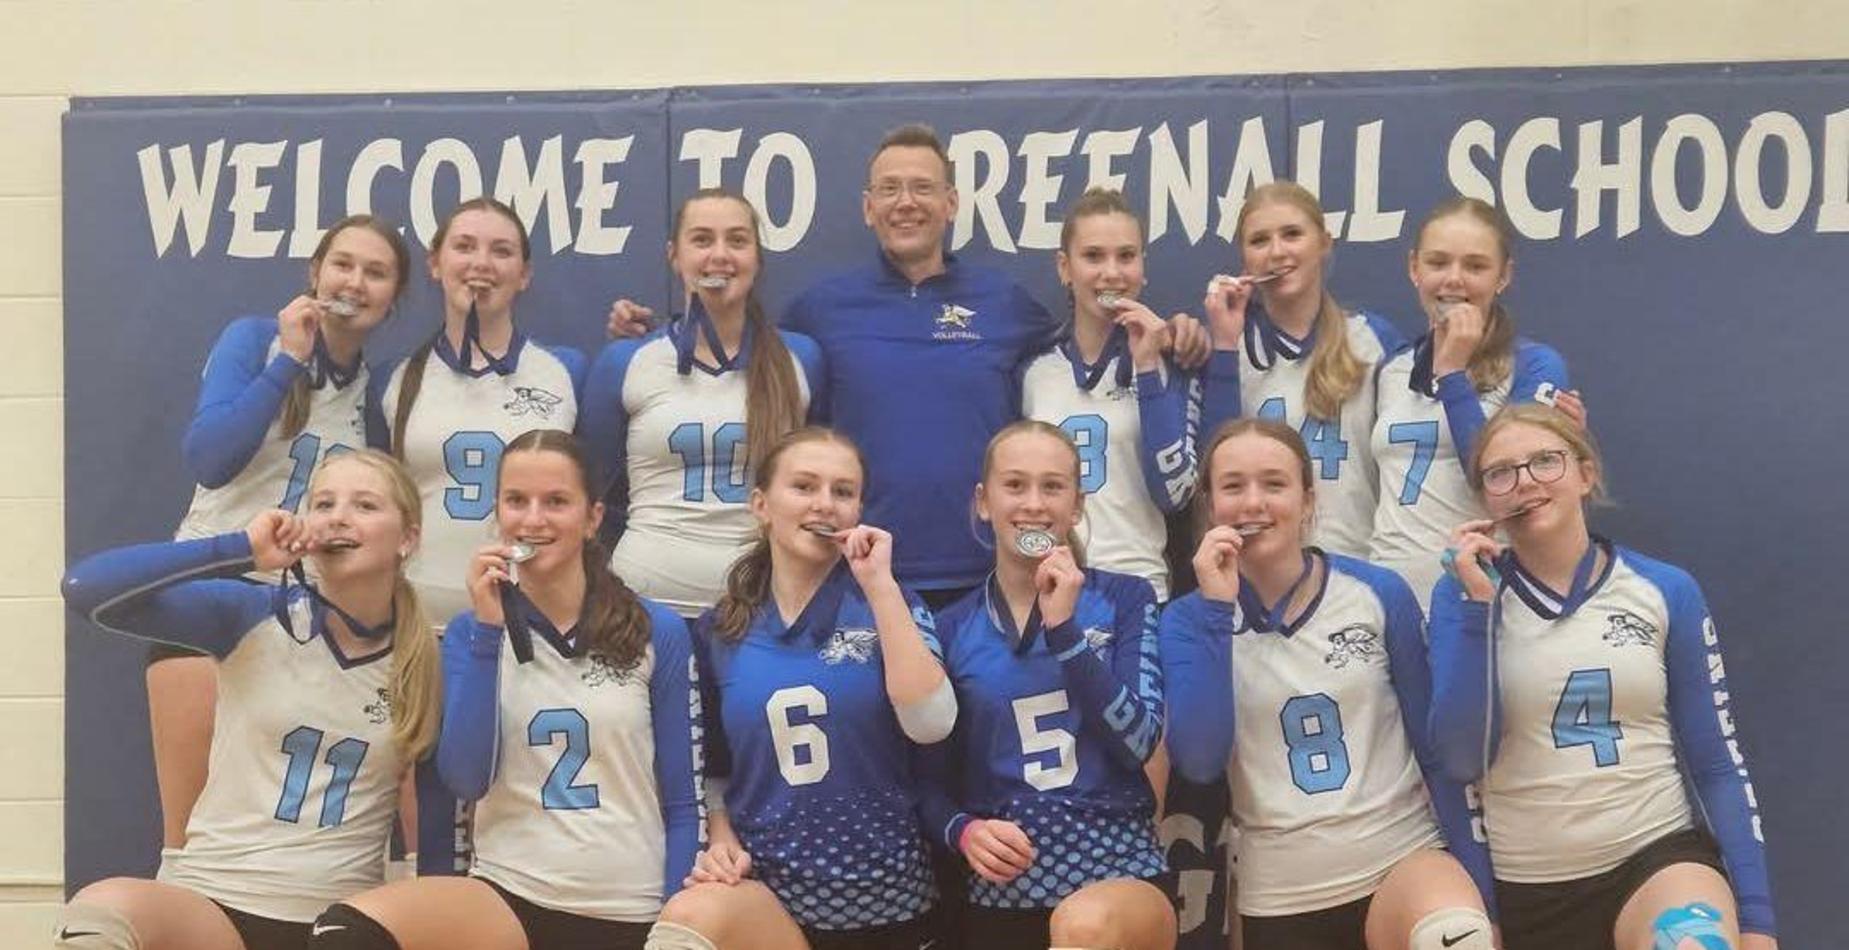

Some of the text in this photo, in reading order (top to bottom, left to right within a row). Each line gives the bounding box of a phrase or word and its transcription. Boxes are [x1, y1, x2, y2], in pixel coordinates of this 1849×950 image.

[137, 134, 635, 259] WELCOME
[679, 127, 817, 253] TO
[946, 116, 1405, 254] REENALL
[278, 432, 356, 515] 1
[443, 431, 506, 520] 9
[667, 422, 749, 503] 10
[1388, 420, 1439, 505] 7
[528, 708, 599, 809] 2
[766, 685, 829, 786] 6
[1011, 690, 1079, 791] 5
[1280, 692, 1352, 794] 8
[1551, 668, 1622, 768] 4
[275, 725, 369, 827] 11
